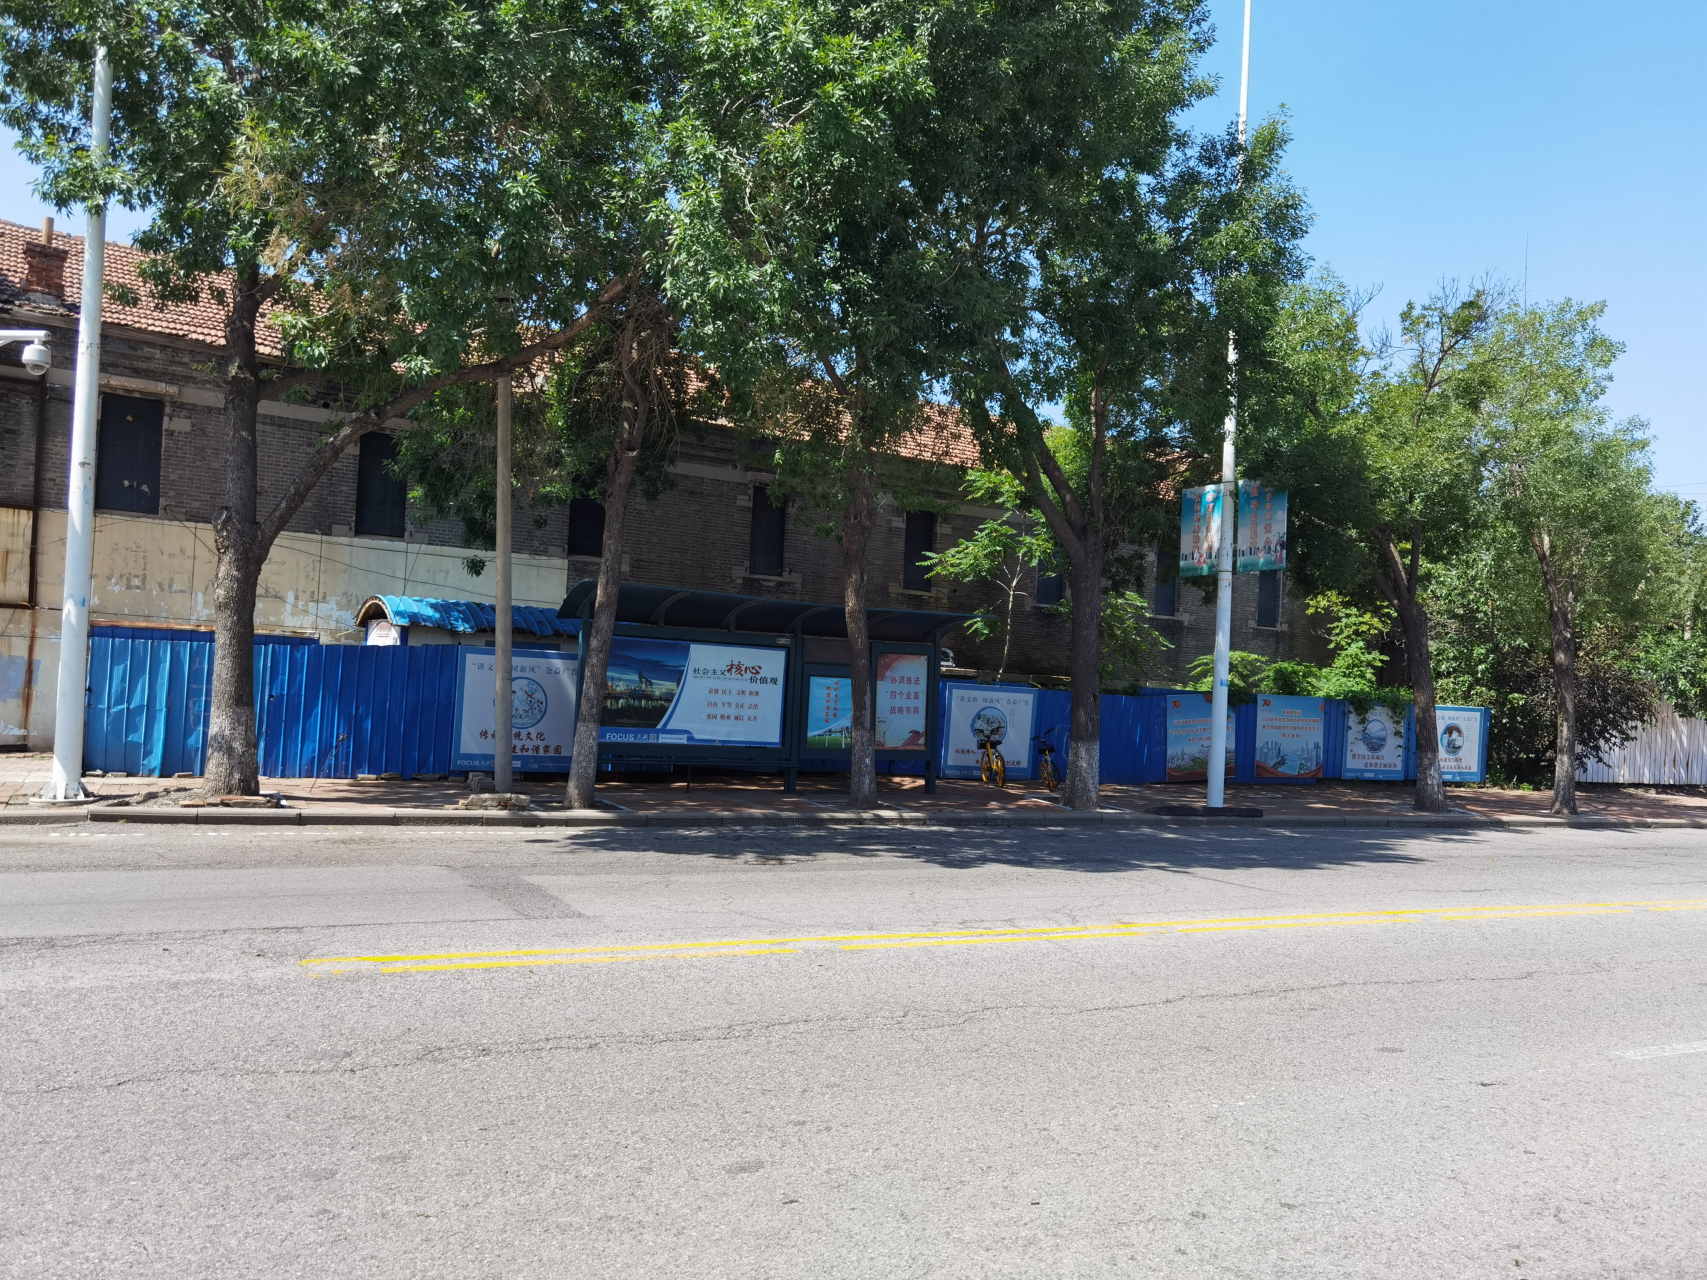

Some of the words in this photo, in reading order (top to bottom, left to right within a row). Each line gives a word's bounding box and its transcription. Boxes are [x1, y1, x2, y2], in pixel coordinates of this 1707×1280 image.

[473, 663, 494, 671] “讲文
[693, 667, 726, 676] 社会主义
[726, 660, 762, 677] 核心
[749, 676, 778, 685] 价值观
[890, 676, 920, 685] 协调推进
[890, 706, 919, 715] 战略布局
[479, 729, 546, 742] 传统文化
[606, 732, 635, 741] FOCUS
[511, 744, 563, 755] 建和谐家园
